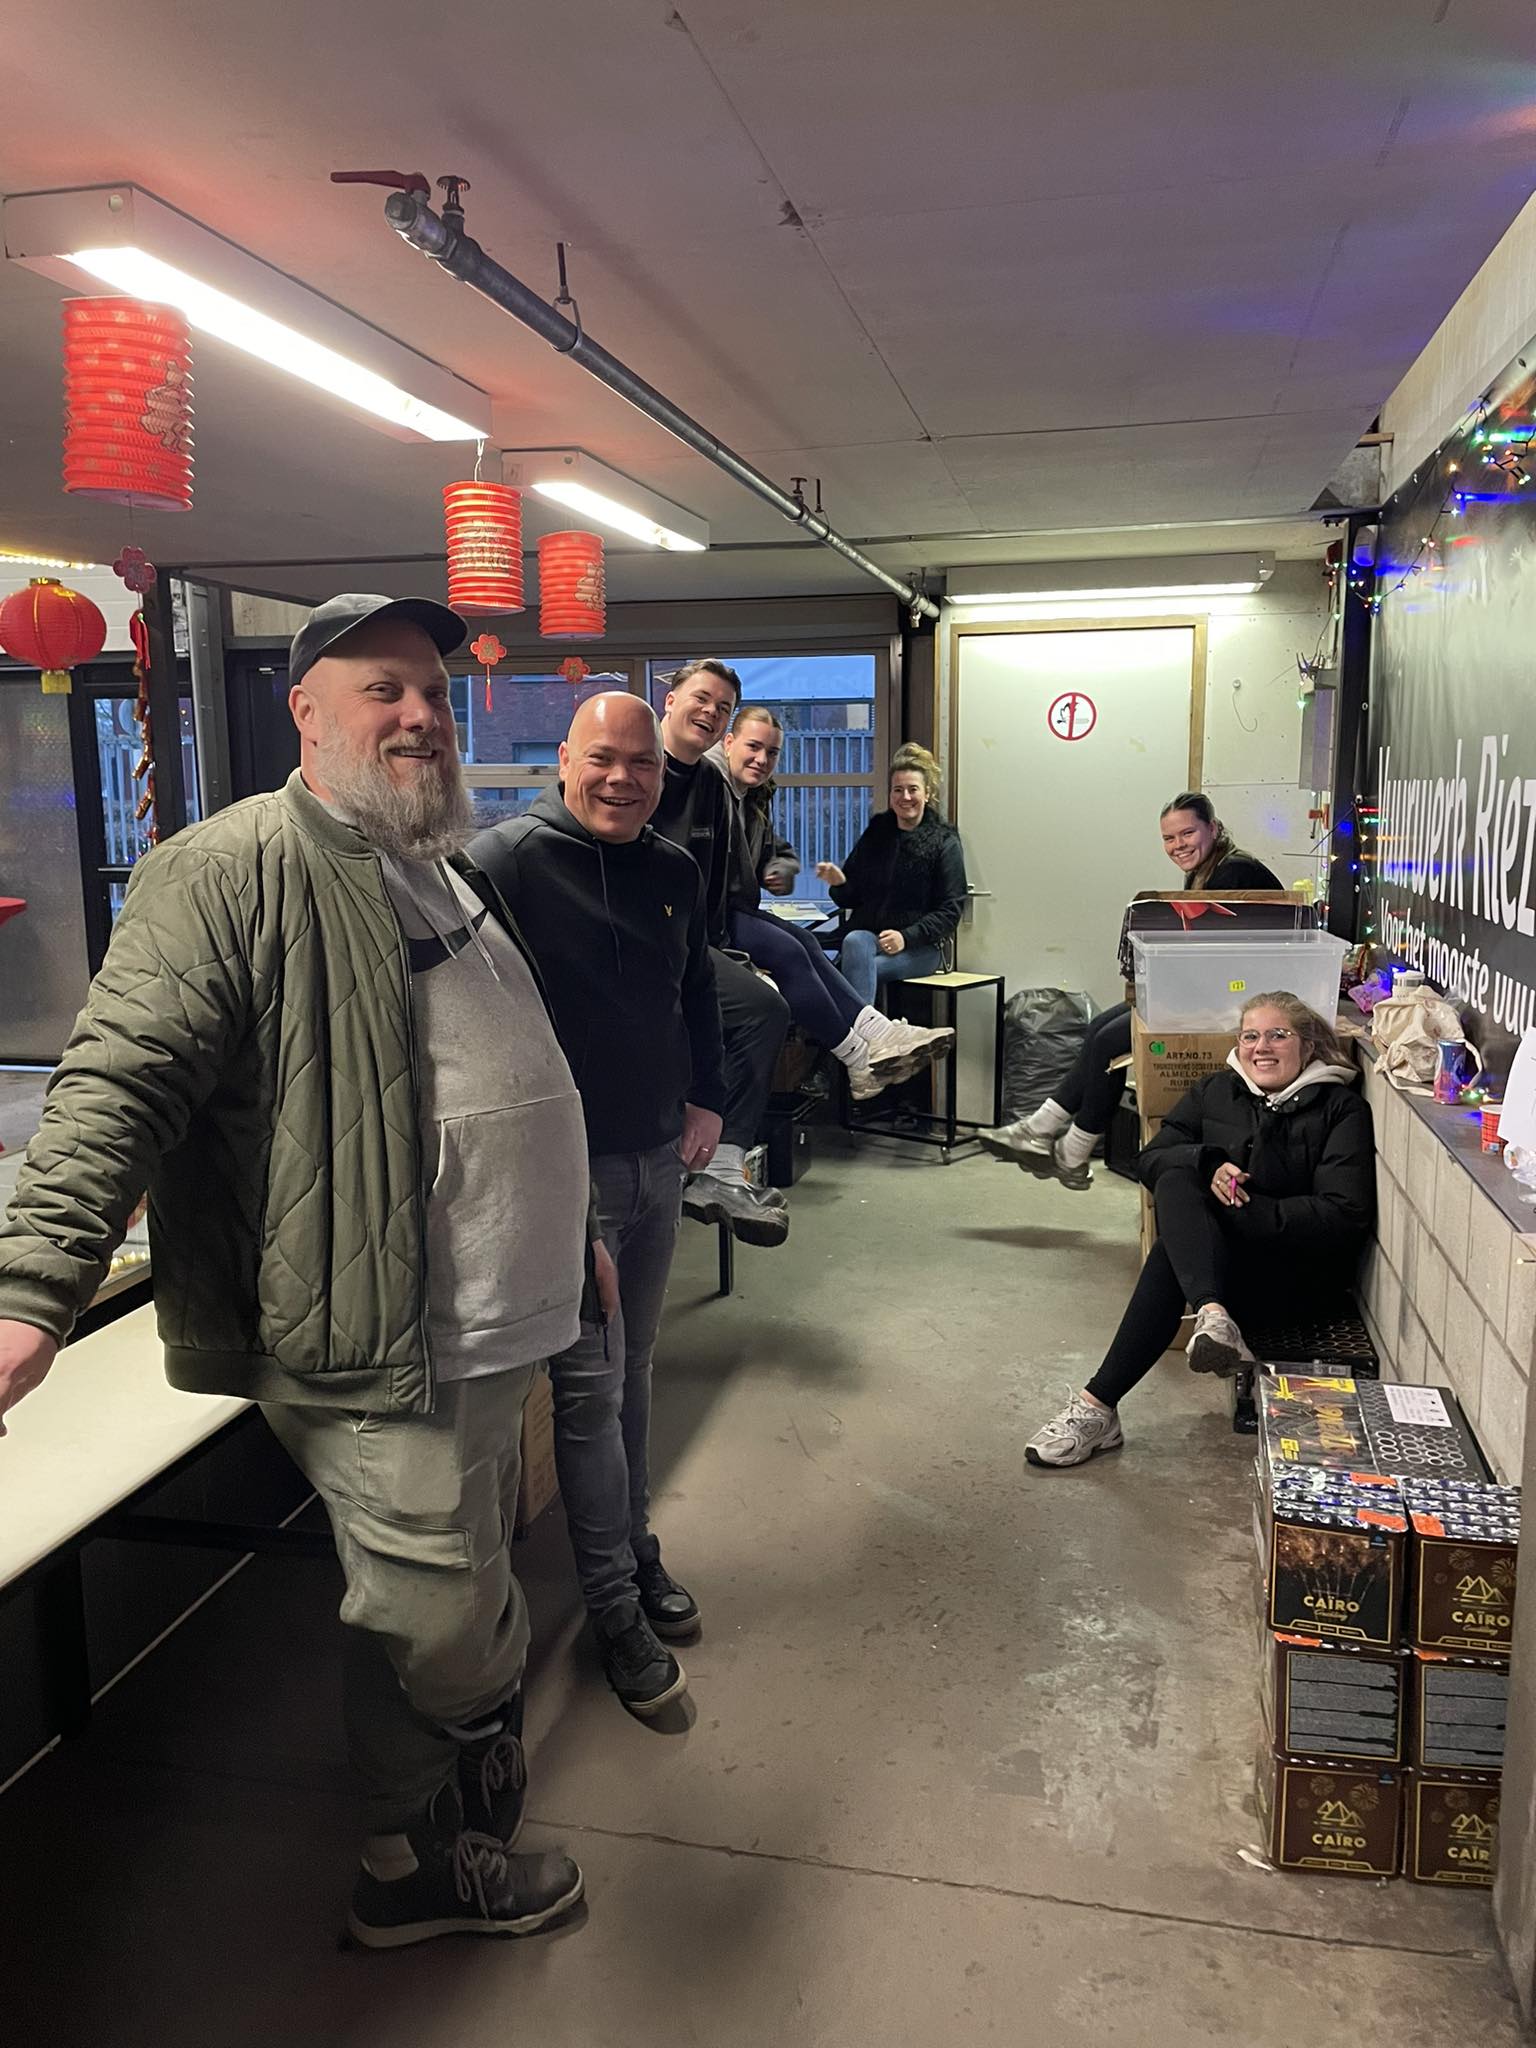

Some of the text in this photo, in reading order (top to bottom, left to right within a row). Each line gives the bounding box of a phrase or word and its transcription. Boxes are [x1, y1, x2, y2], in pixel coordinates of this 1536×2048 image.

[1377, 734, 1536, 937] Vuurwerk Riez
[1381, 897, 1405, 957] Voor
[1405, 908, 1426, 973] het
[1428, 933, 1489, 1014] mooiste
[1303, 1596, 1360, 1613] CAÏRO
[1452, 1611, 1510, 1627] CAÏRO
[1312, 1832, 1366, 1848] CAÏRO
